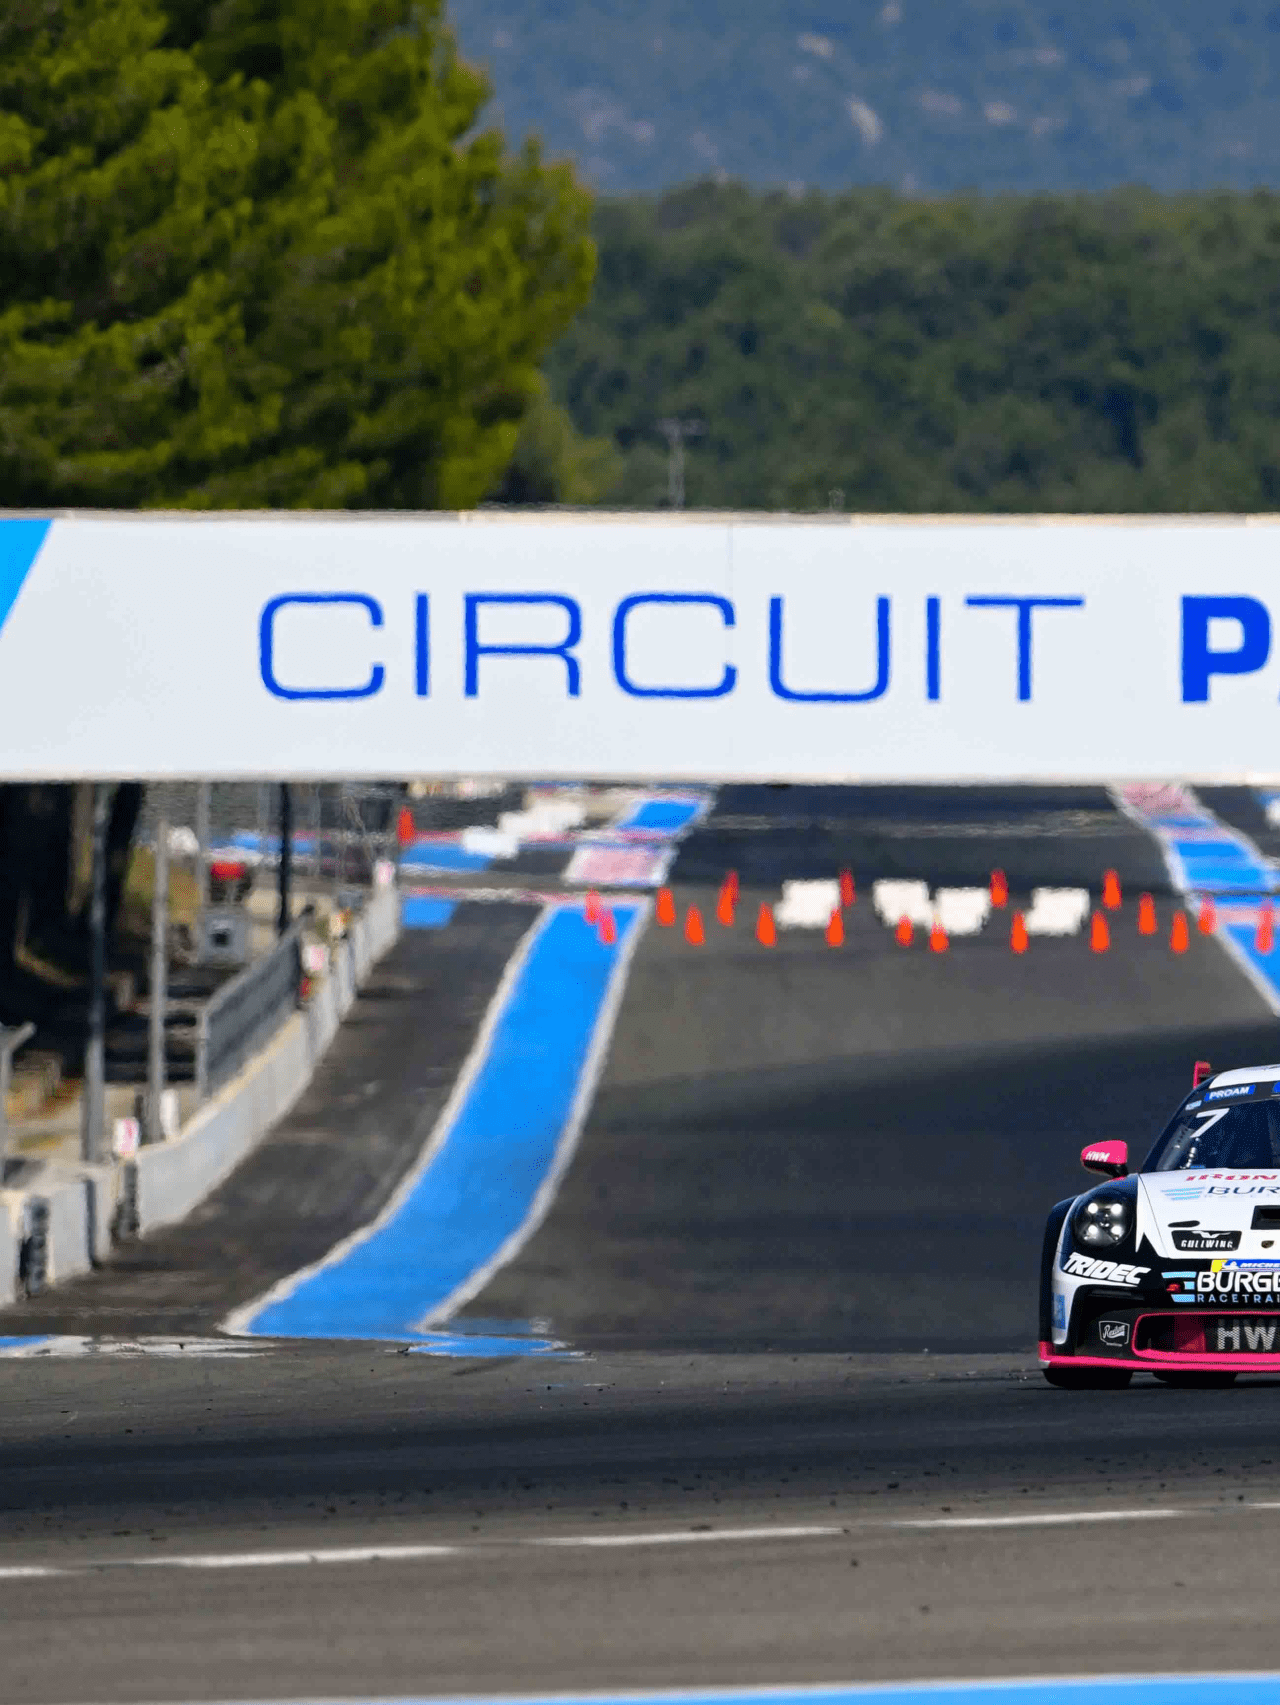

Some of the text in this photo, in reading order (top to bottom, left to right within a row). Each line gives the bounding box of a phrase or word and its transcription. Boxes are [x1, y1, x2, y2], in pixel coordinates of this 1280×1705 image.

[258, 591, 1086, 702] CIRCUIT
[1208, 1086, 1251, 1100] PROAM
[1189, 1107, 1231, 1139] 7
[1085, 1150, 1111, 1163] HWM
[1062, 1251, 1152, 1285] TRIDEC
